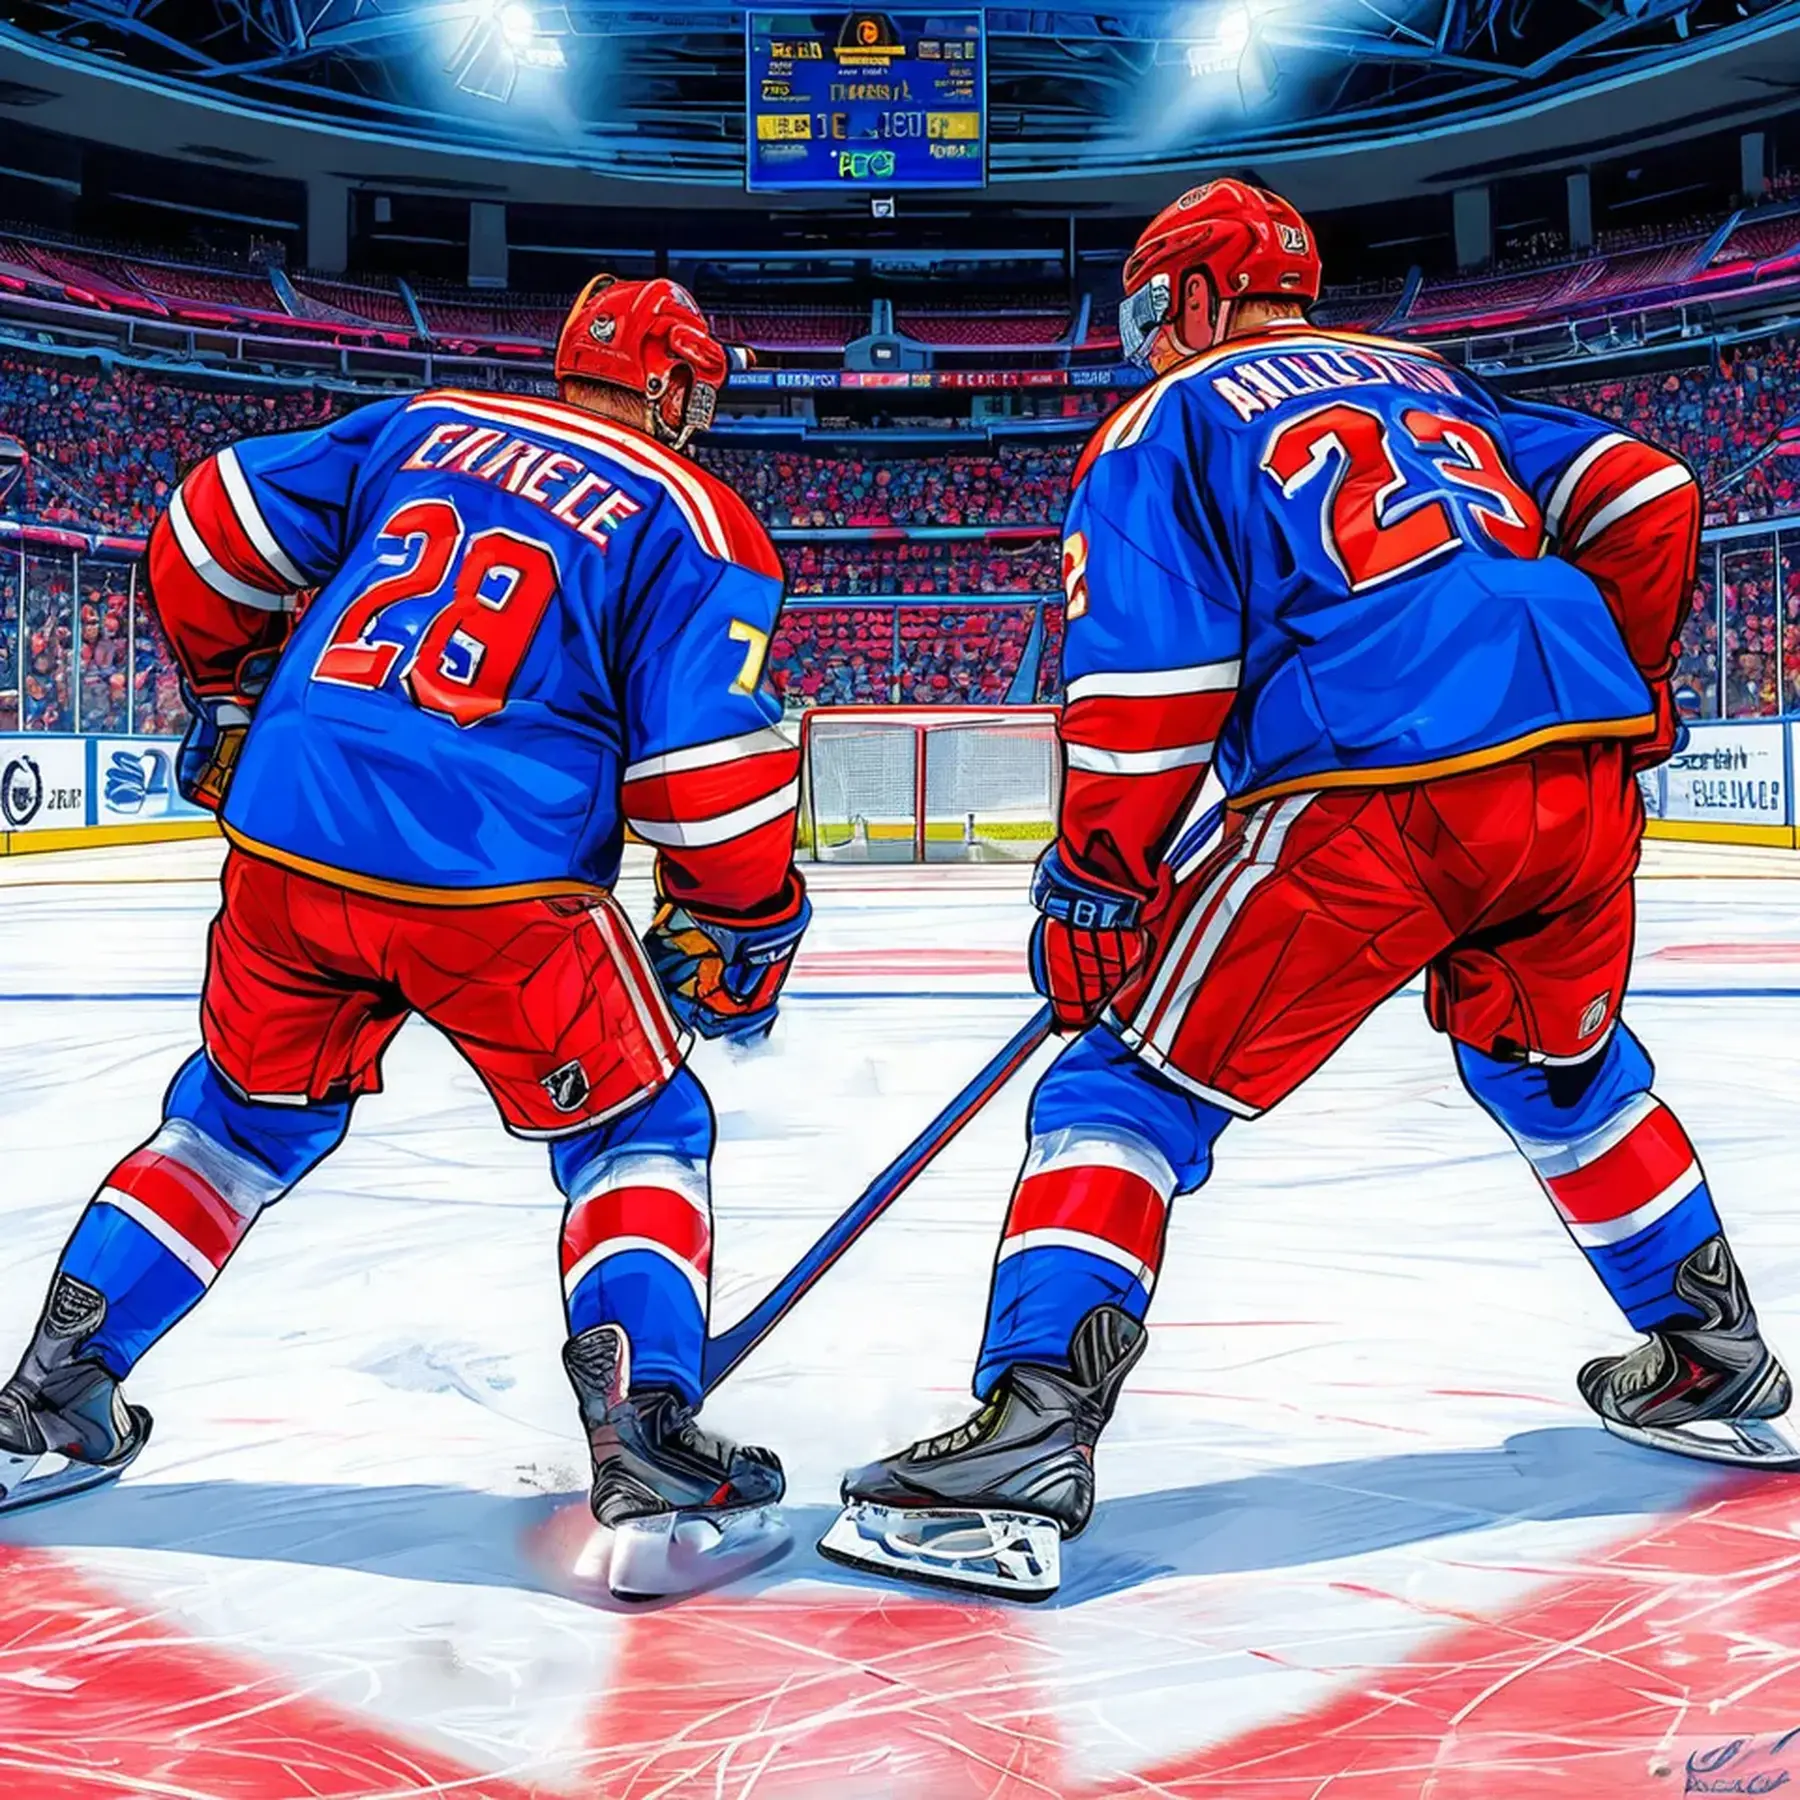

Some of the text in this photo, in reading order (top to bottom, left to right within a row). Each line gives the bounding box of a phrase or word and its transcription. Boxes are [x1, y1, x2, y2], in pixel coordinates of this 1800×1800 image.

[1259, 400, 1543, 594] 23
[309, 496, 563, 730] 28
[727, 618, 769, 697] 7
